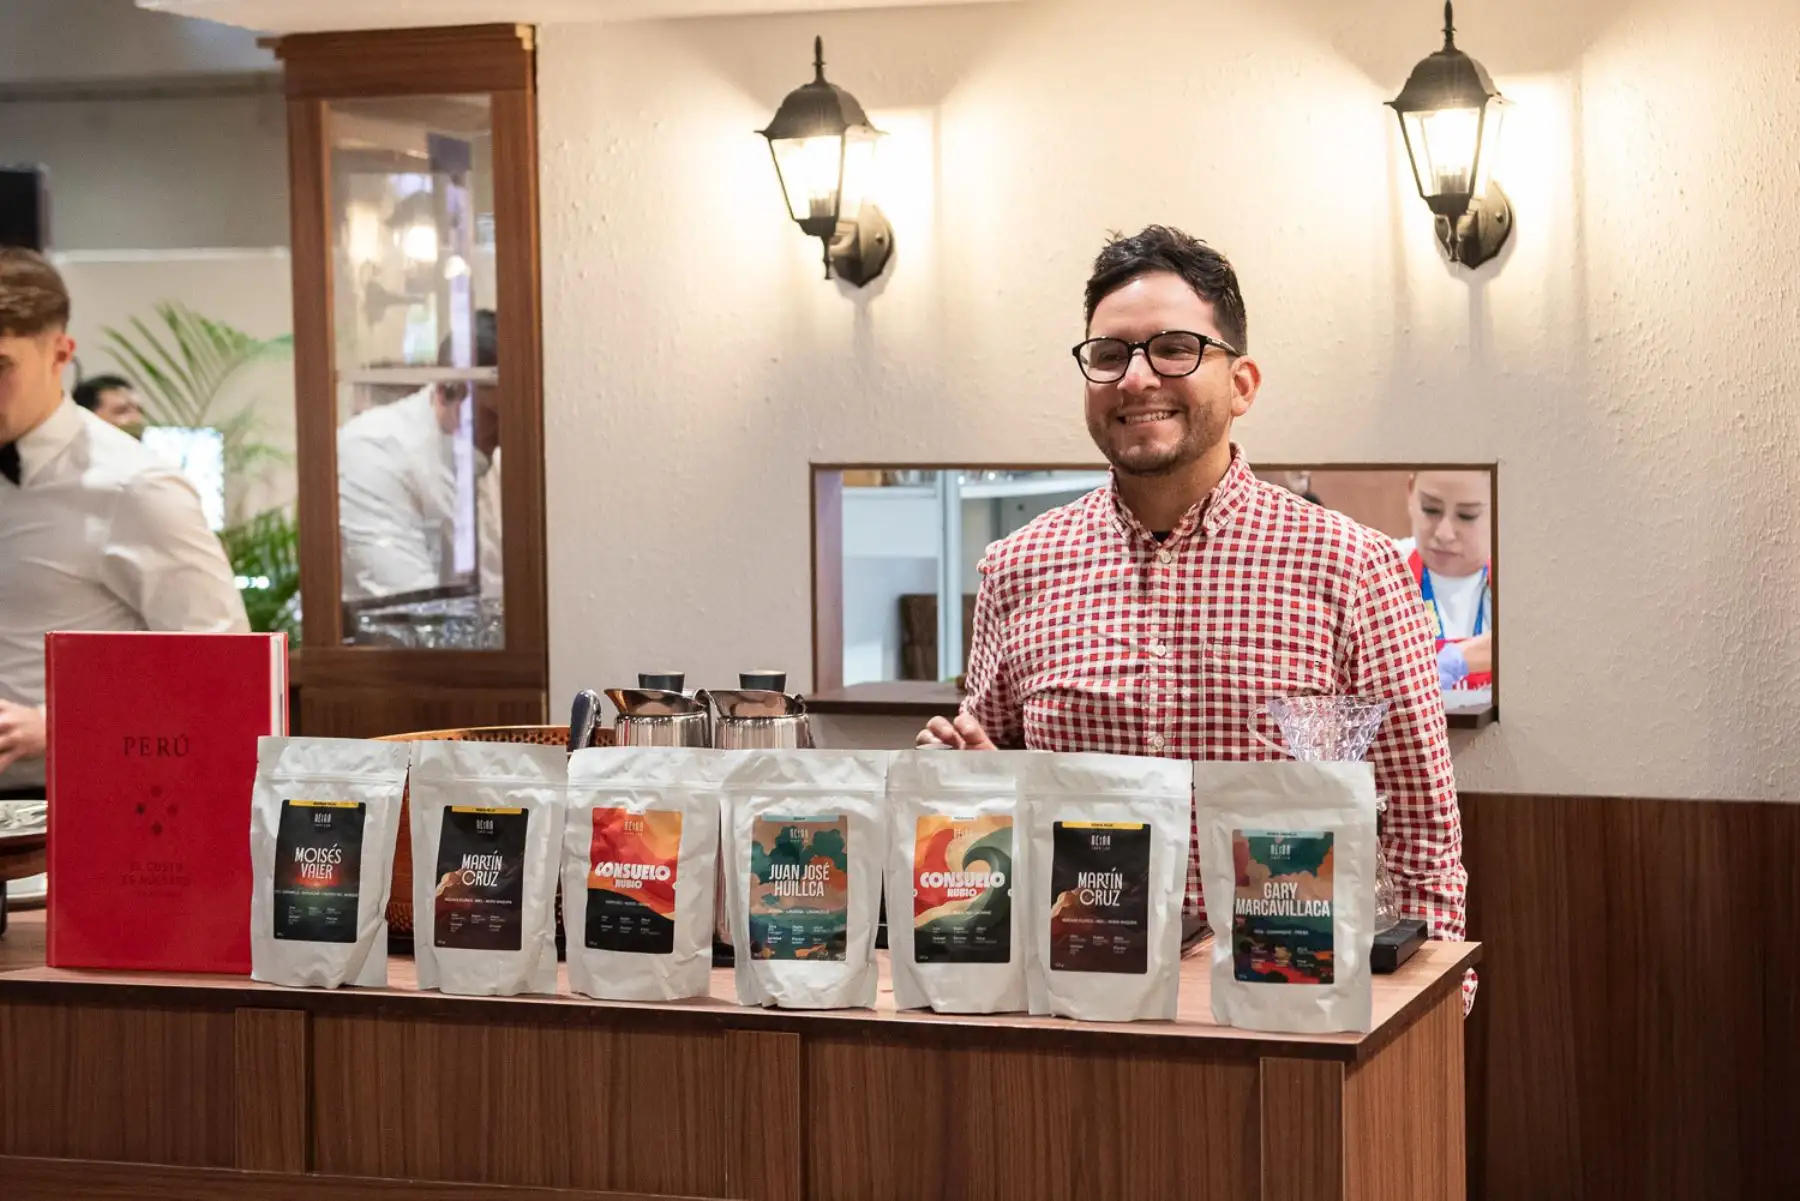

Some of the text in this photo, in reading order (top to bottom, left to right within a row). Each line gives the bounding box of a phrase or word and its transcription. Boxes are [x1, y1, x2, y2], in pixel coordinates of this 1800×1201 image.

[122, 732, 190, 758] PERÚ
[294, 843, 342, 865] MOISÉS
[461, 849, 503, 871] MARTÍN
[301, 863, 333, 880] VALER
[462, 869, 500, 887] CRUZ
[594, 861, 671, 881] CONSUELO
[768, 861, 830, 881] JUAN JOSÉ
[920, 871, 1006, 889] CONSUELO
[1077, 866, 1123, 889] MARTÍN
[615, 879, 643, 889] RUBIO
[774, 880, 825, 897] HUILLCA
[947, 887, 977, 898] RUBIO
[1263, 881, 1298, 899] GARY
[1079, 888, 1121, 907] CRUZ
[1235, 898, 1331, 917] MARCAVILLACA
